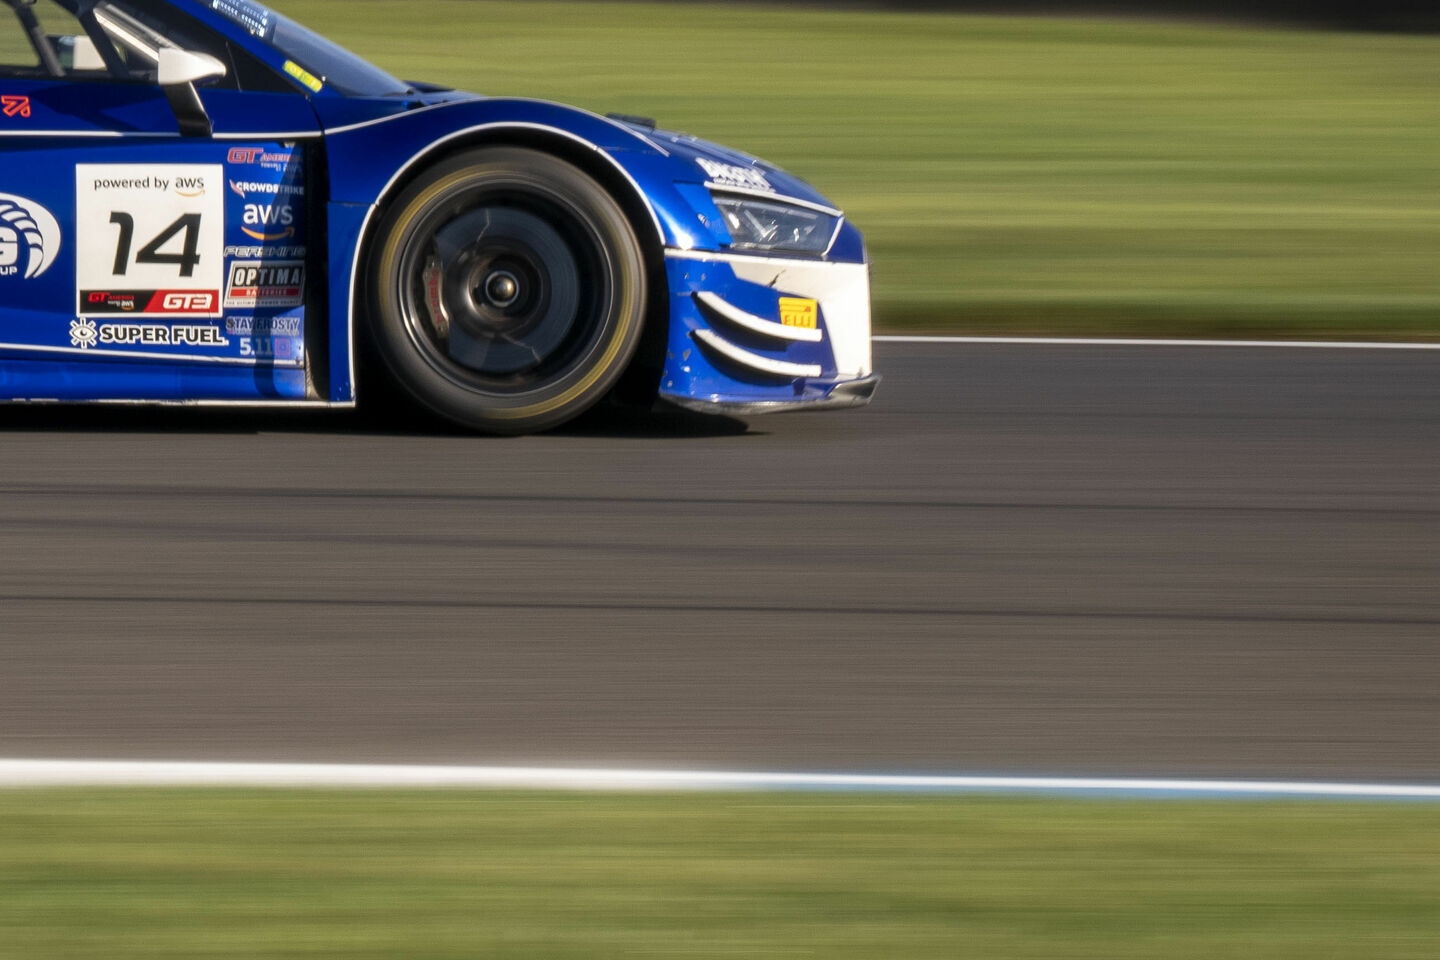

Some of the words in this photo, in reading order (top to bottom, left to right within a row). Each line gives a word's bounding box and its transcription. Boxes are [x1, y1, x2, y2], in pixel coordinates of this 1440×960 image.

[227, 147, 264, 164] GT
[93, 176, 150, 190] powered
[154, 176, 169, 191] by
[175, 177, 204, 189] aws
[236, 182, 304, 196] CROWDSTRIKE
[243, 203, 293, 225] aws
[109, 211, 202, 277] 14
[234, 268, 301, 286] OPTIMA
[163, 293, 213, 310] GT3
[99, 324, 170, 344] SUPER
[240, 337, 274, 356] 5.11
